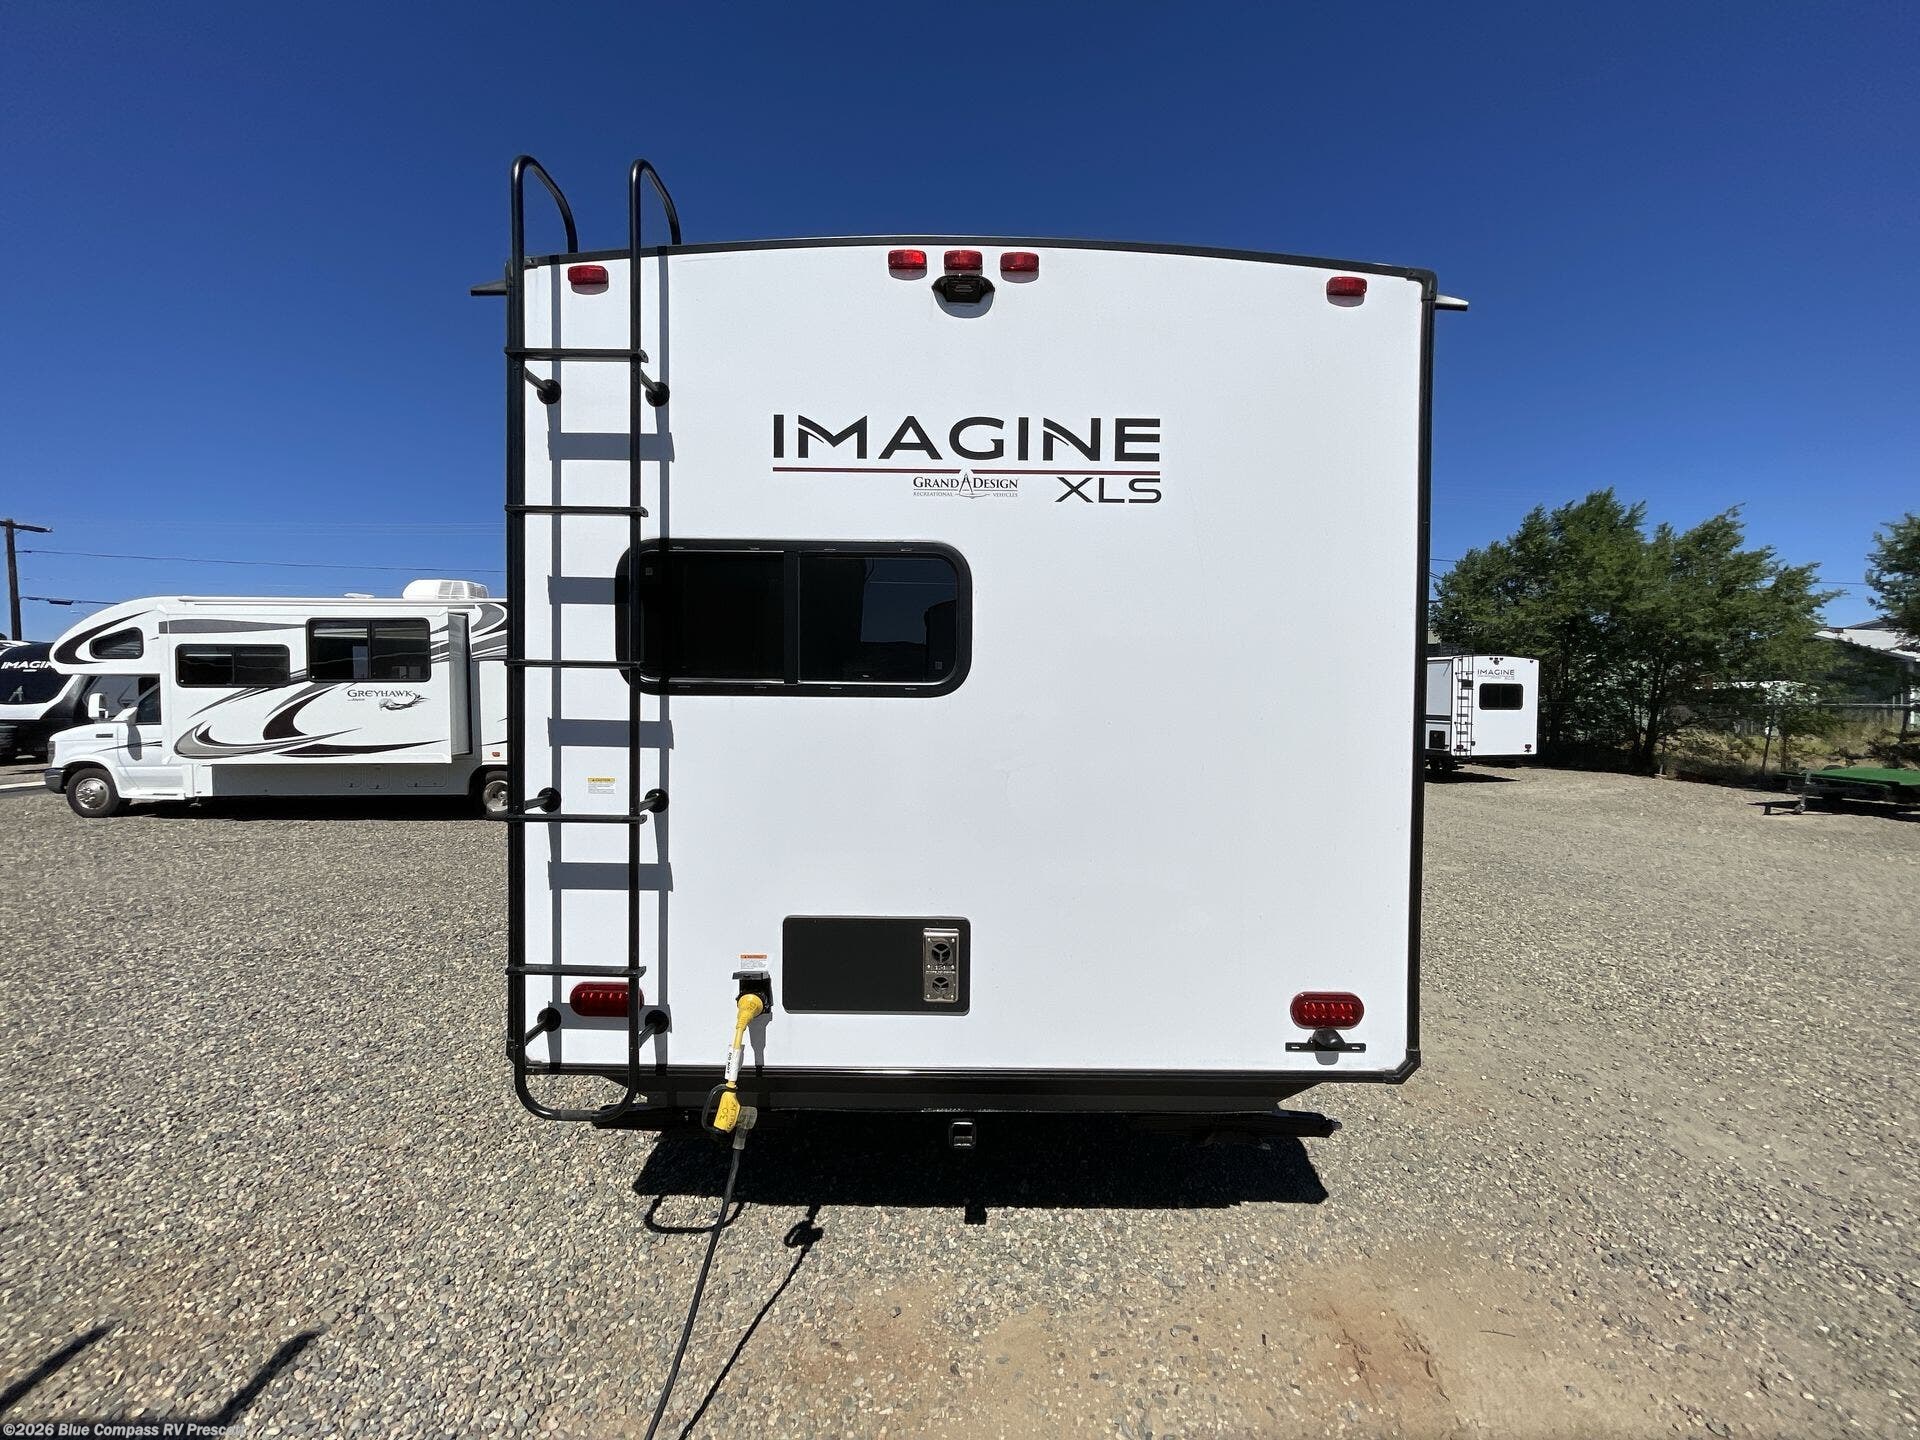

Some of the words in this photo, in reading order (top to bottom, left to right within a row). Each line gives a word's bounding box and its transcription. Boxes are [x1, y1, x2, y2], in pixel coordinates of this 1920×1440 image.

[772, 413, 1161, 462] IMAGINE
[913, 476, 960, 489] GRAND
[973, 477, 1019, 489] DESIGN
[1054, 476, 1162, 504] XLS
[0, 660, 54, 670] IMAGIN
[347, 689, 413, 697] GREYHAWK
